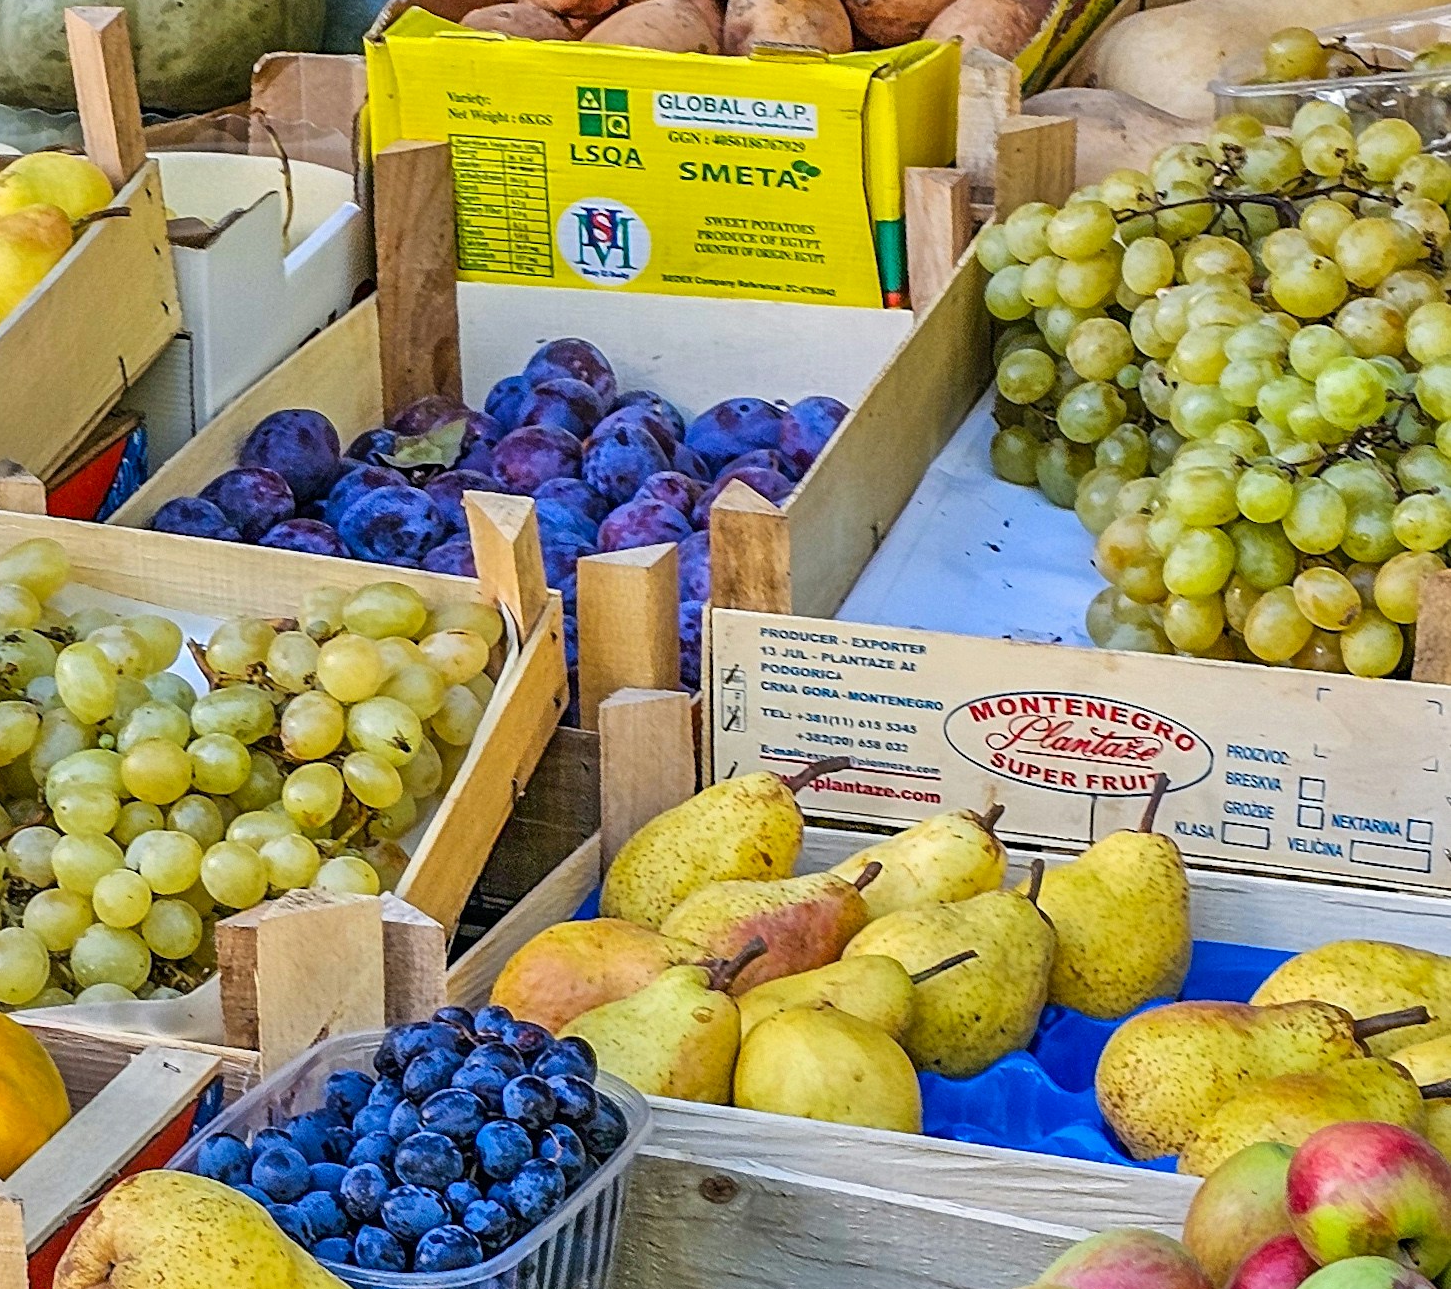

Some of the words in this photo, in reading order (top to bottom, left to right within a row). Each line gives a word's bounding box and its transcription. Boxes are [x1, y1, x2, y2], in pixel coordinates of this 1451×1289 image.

[447, 107, 469, 120] Net
[469, 109, 510, 125] Weight
[658, 94, 746, 116] GLOBAL
[752, 101, 812, 122] G.A.P.
[667, 130, 701, 145] GGN
[570, 143, 644, 167] LSQA
[704, 216, 749, 230] SWEET
[751, 220, 817, 235] POTATOES
[697, 229, 758, 244] PRODUCE
[760, 235, 778, 245] OF
[780, 237, 823, 250] EGYPT
[694, 242, 741, 256] COUNTRY
[741, 247, 754, 257] OF
[794, 251, 827, 264] EGYPT
[759, 627, 839, 646] PRODUCER
[851, 638, 928, 655] EXPORTER
[759, 646, 777, 657] 13
[781, 649, 808, 660] JUL
[821, 653, 896, 671] PLANTAZE
[760, 663, 844, 681] PODGORICA
[760, 681, 799, 696] CRNA
[802, 686, 840, 700] GORA
[795, 712, 855, 729] +381(11)
[885, 721, 918, 735] 5345
[967, 696, 1197, 753] MONTENEGRO
[795, 732, 855, 748] +382(20)
[858, 738, 882, 751] 658
[885, 740, 910, 753] 032
[985, 715, 1163, 763] Plantaže
[990, 752, 1077, 788] SUPER
[1225, 771, 1283, 792] BRESKVA
[1175, 821, 1215, 839] KLASA
[1331, 813, 1403, 837] NEKTARINA
[1287, 836, 1344, 859] VELIČINA
